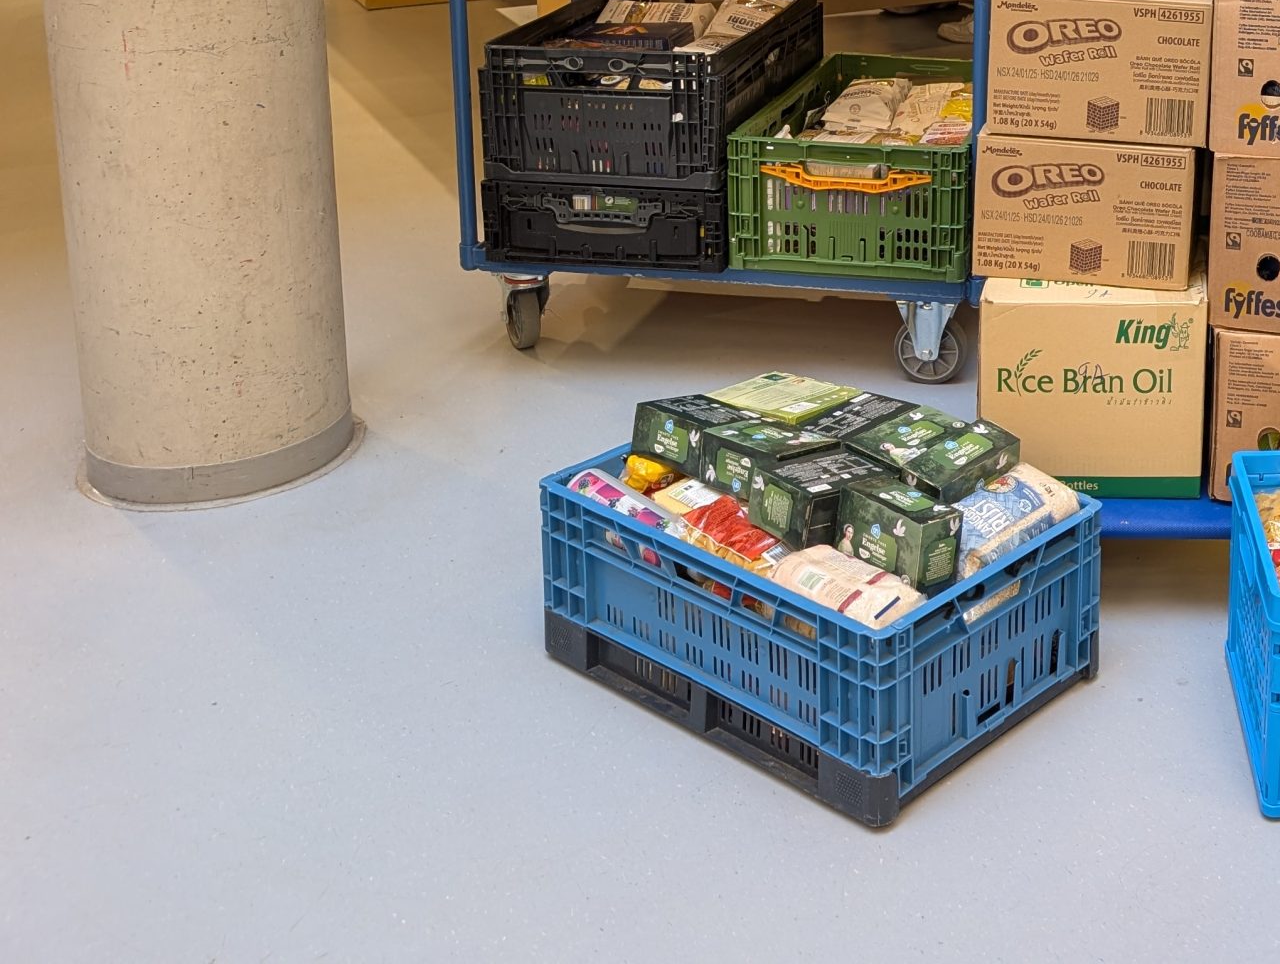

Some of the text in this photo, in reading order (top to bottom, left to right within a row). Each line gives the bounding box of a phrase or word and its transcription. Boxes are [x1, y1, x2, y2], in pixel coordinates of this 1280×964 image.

[1134, 8, 1200, 22] VSPH 4261955
[1007, 18, 1122, 54] OREO
[1157, 36, 1200, 47] CHOCOLATE
[1089, 45, 1118, 60] Roll
[997, 67, 1011, 76] NSX
[1041, 69, 1054, 79] HSD
[1054, 70, 1080, 82] 24/01/26
[993, 117, 1008, 125] 1.08
[1010, 118, 1019, 127] Kg
[1021, 119, 1032, 127] (20
[1041, 120, 1057, 129] 54g)
[1117, 153, 1183, 167] VSPH 4261955
[991, 163, 1105, 198] OREO
[1140, 181, 1182, 192] CHOCOLATE
[1072, 190, 1100, 204] Roll
[981, 210, 993, 219] NSX
[1024, 213, 1037, 222] HSD
[977, 259, 992, 267] 1.08
[994, 260, 1003, 269] Kg
[1005, 261, 1016, 269] (20
[1024, 263, 1040, 272] 54g)
[1115, 318, 1173, 350] King
[997, 367, 1172, 396] Rice Bran Oil
